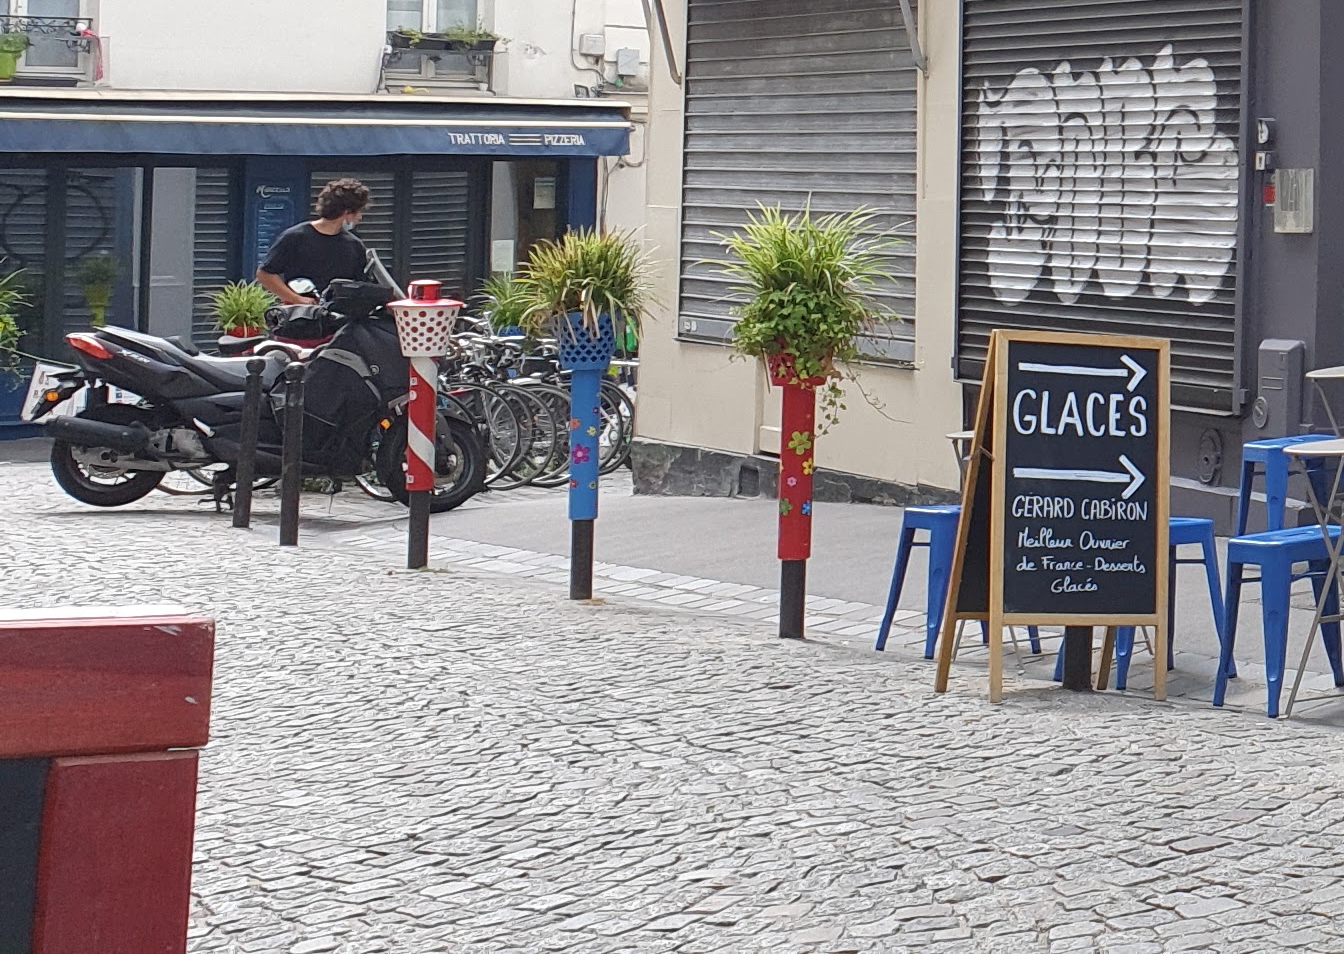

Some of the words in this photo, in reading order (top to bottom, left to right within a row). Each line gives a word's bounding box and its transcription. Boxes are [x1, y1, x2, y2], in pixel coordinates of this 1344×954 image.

[448, 132, 506, 145] TRATTORIA
[544, 133, 585, 145] PIZZERIA
[1012, 388, 1148, 438] GLACES
[1081, 497, 1148, 521] CABIRON
[1018, 527, 1074, 550] Meilleur
[1079, 531, 1131, 550] Ouvrier
[1016, 557, 1037, 572] de
[1051, 576, 1099, 594] Glacés
